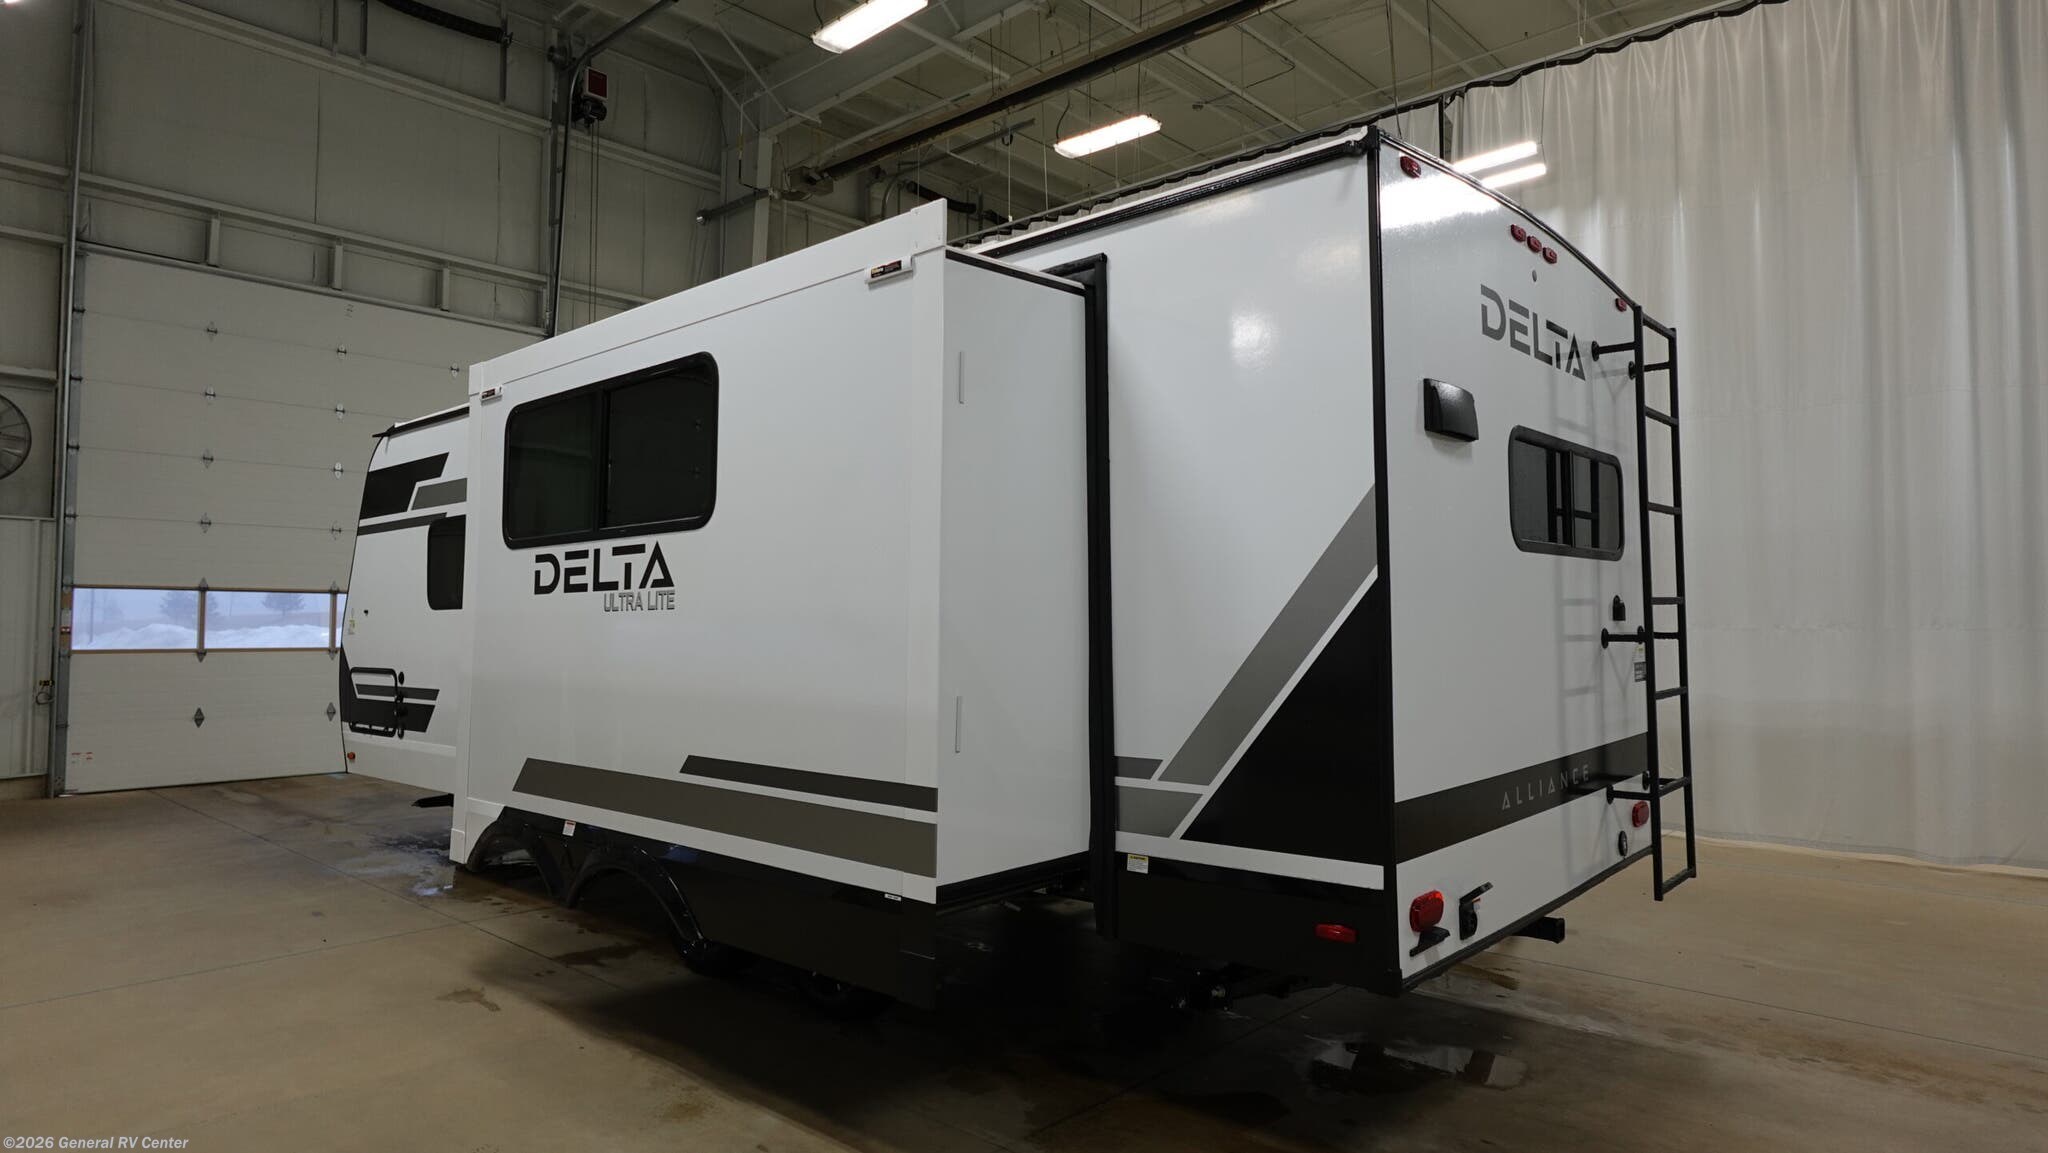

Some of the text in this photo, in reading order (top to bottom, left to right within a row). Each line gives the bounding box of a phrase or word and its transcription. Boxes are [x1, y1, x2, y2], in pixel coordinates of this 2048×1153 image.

[1480, 284, 1585, 381] DELTA
[534, 541, 675, 595] DELTA
[604, 589, 675, 612] ULTRA LITE
[1502, 764, 1589, 810] ALLIANCE
